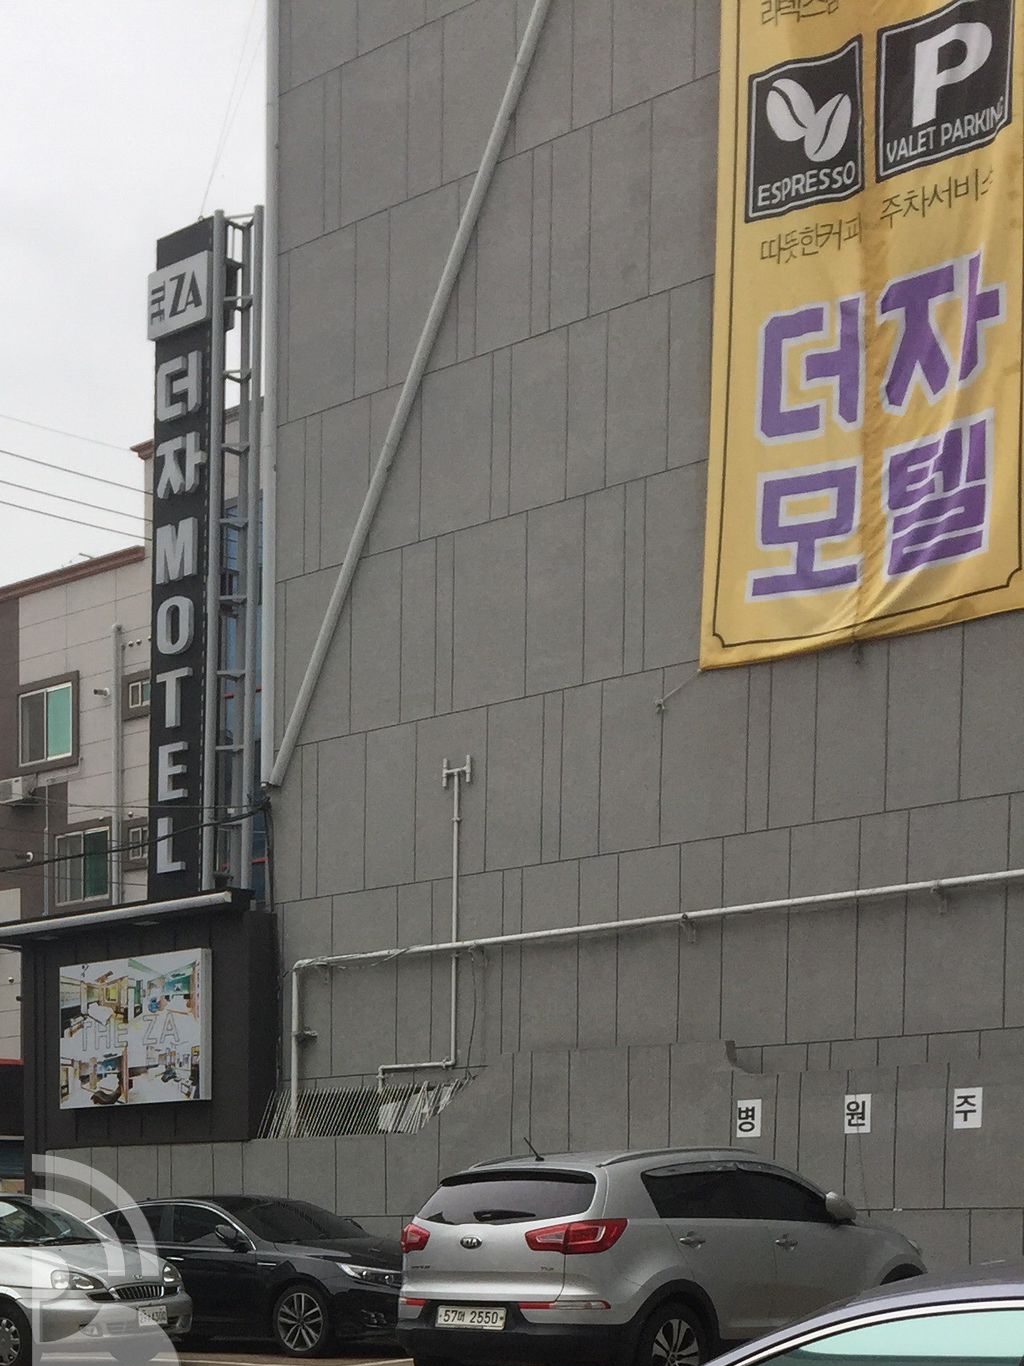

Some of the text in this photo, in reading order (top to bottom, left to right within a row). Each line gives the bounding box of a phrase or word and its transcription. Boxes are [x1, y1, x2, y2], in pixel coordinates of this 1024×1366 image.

[912, 21, 993, 129] P
[885, 94, 1004, 164] VALET PARKING
[756, 159, 857, 208] ESPRESSO
[756, 250, 1005, 443] 더자
[747, 411, 993, 601] 모텔
[469, 1310, 499, 1325] 2550
